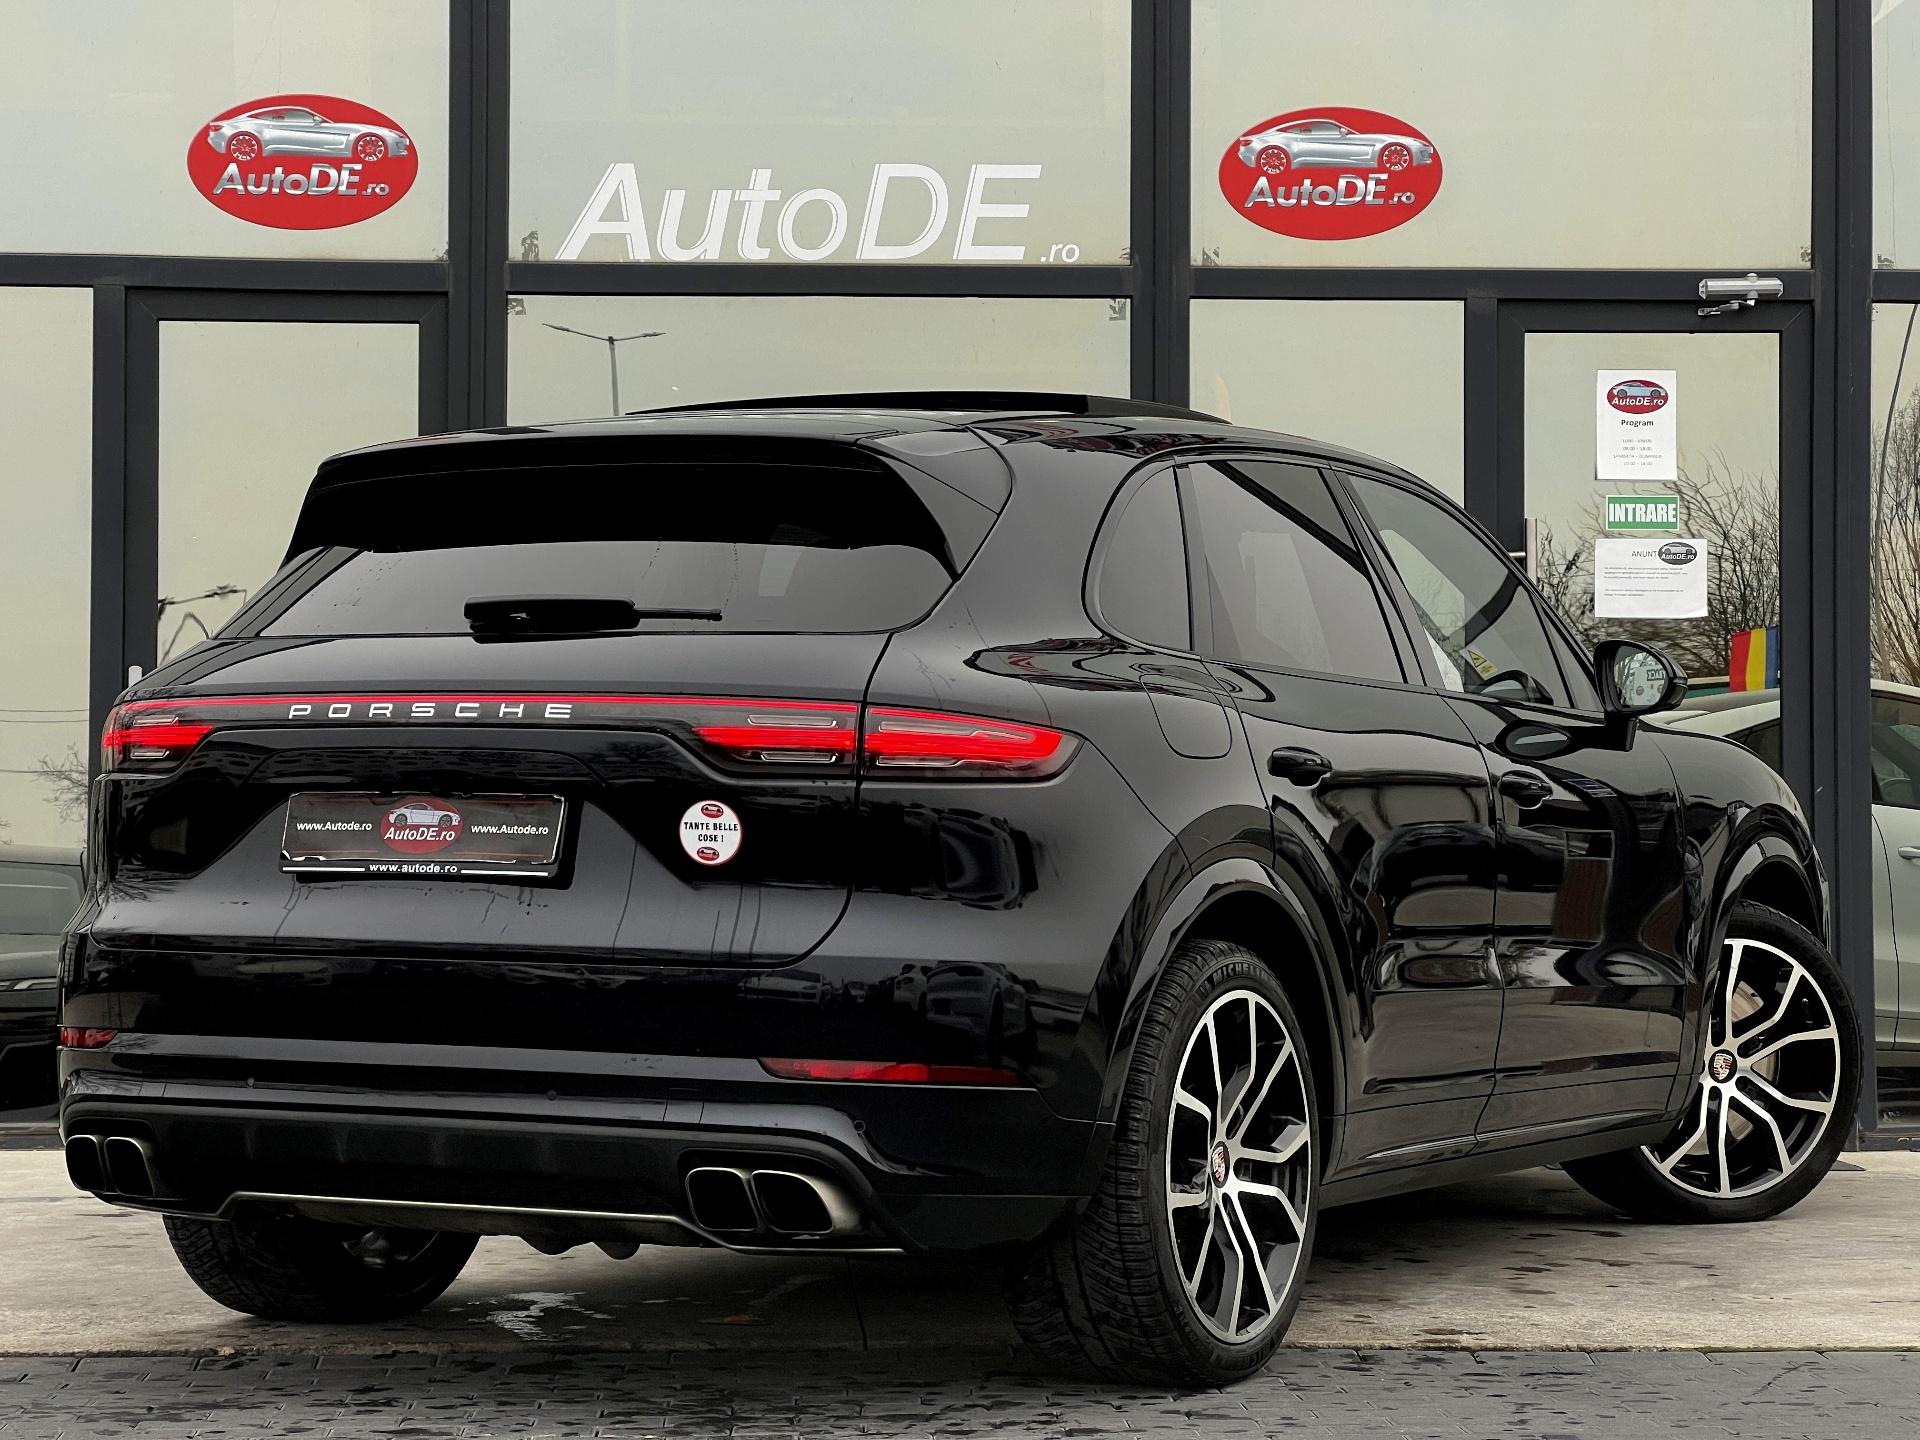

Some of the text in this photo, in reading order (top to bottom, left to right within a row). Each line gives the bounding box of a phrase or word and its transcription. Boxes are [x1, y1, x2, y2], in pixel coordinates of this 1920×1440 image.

[1611, 397, 1664, 407] AutoDE.ro
[1621, 419, 1654, 427] Program
[1608, 503, 1677, 523] INTRARE
[288, 702, 573, 719] PORSCHE
[296, 821, 373, 831] www.Autode.ro
[470, 824, 549, 835] www.Autode.ro
[683, 821, 739, 832] TANTE BELLE
[383, 827, 456, 841] AutoDE.ro
[697, 833, 719, 842] COSE
[369, 862, 458, 874] www.autode.ro
